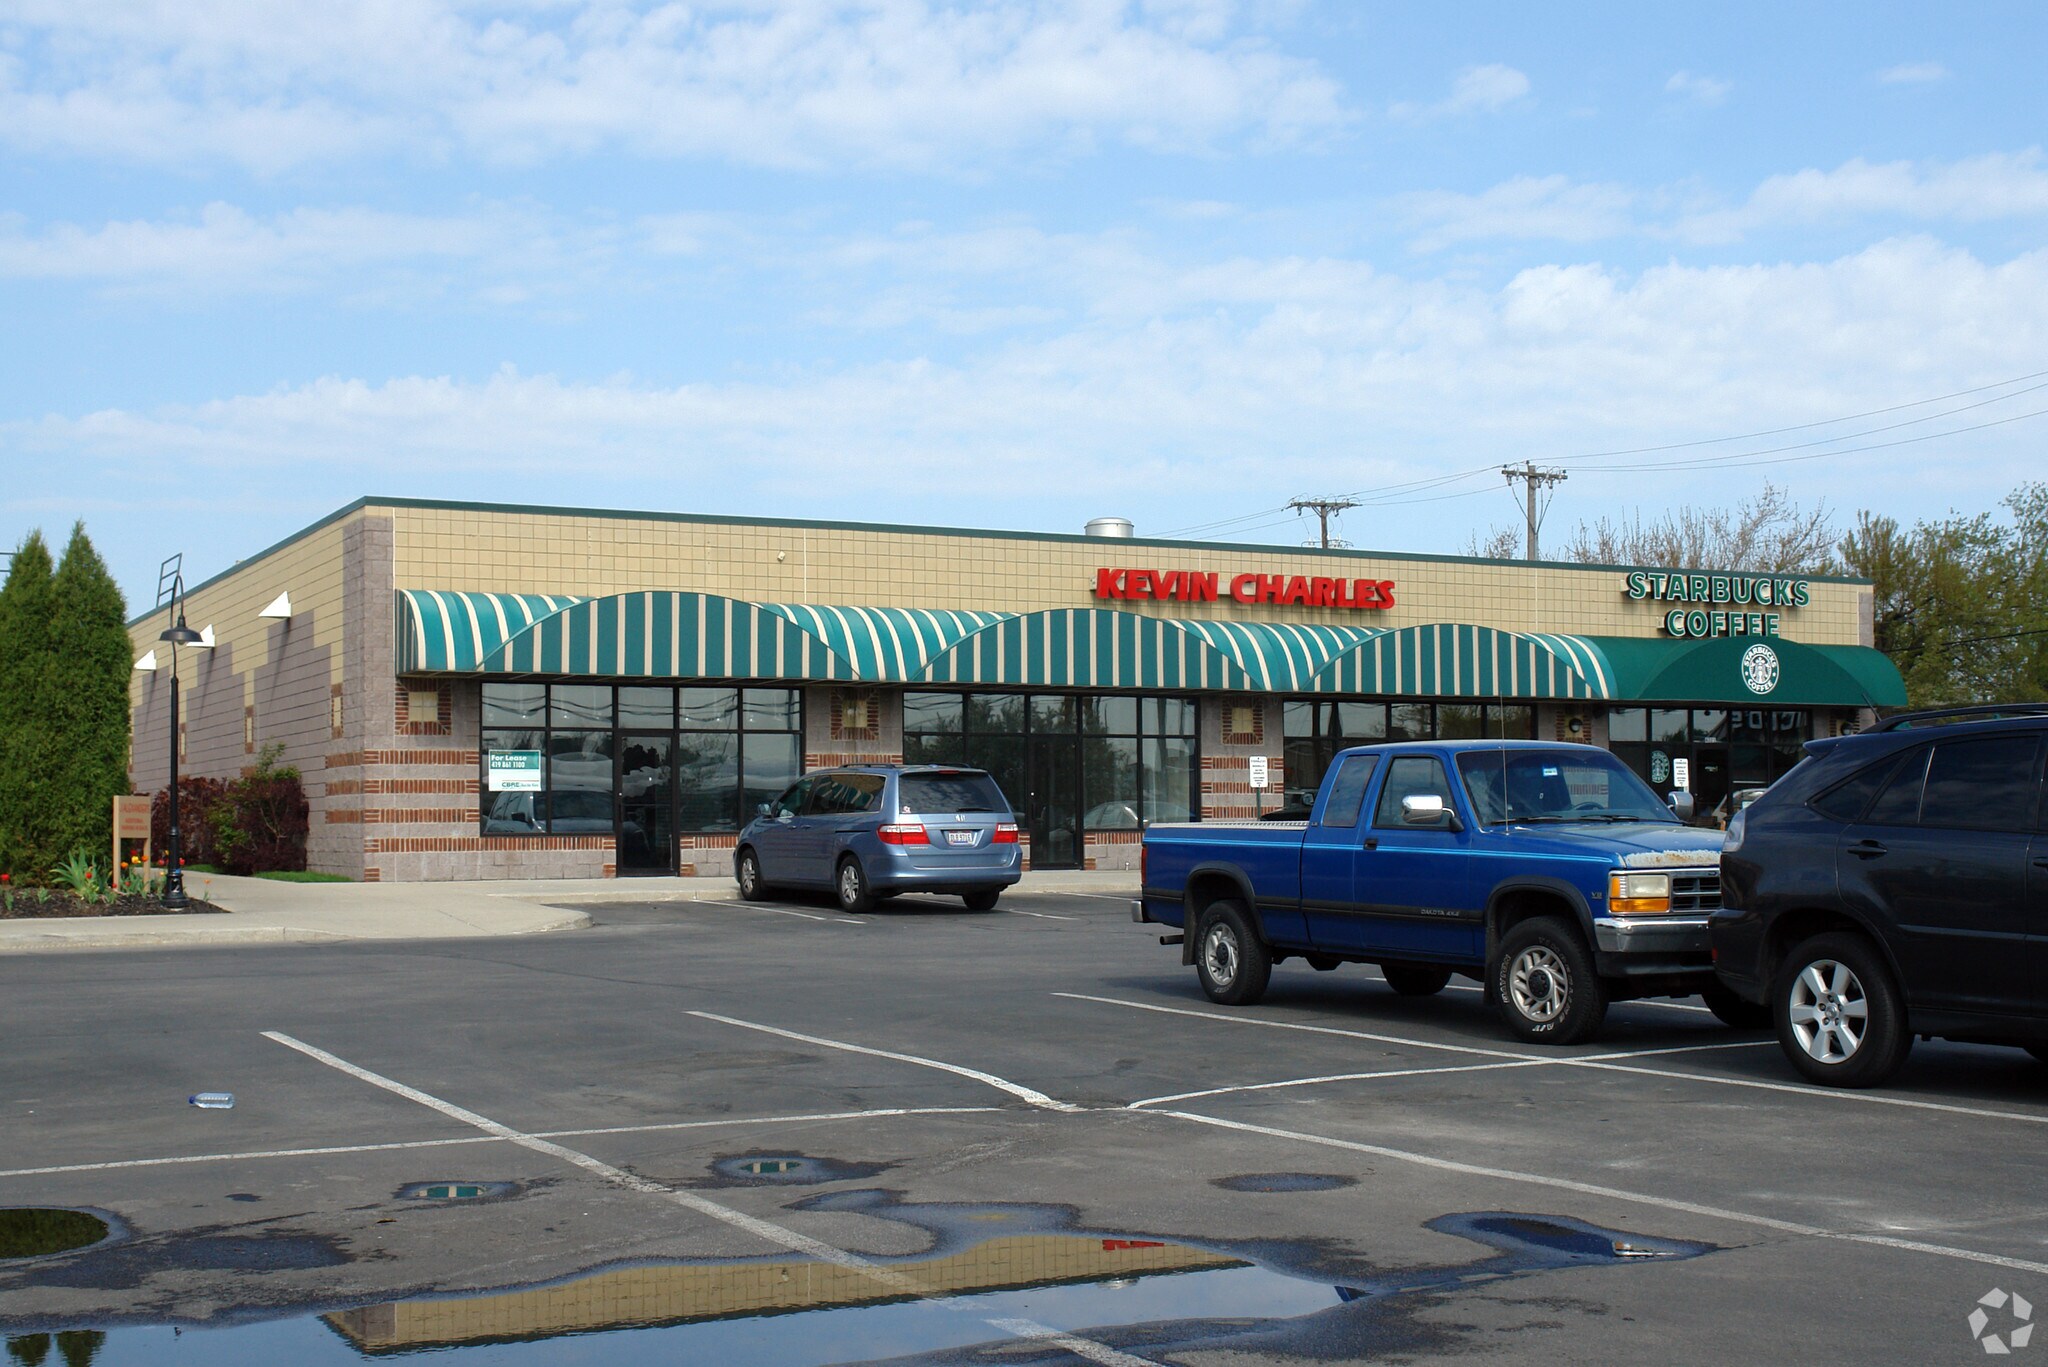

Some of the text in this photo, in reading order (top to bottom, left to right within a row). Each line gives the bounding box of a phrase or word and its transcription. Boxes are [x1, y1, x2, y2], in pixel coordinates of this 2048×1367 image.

[1096, 568, 1396, 609] KEVIN CHARLES
[1628, 571, 1811, 607] STARBUCKS
[1665, 609, 1780, 638] COFFEE
[1743, 646, 1777, 668] STARBUCKS
[1747, 678, 1773, 692] COFFEE
[1420, 908, 1445, 916] DAKOTA
